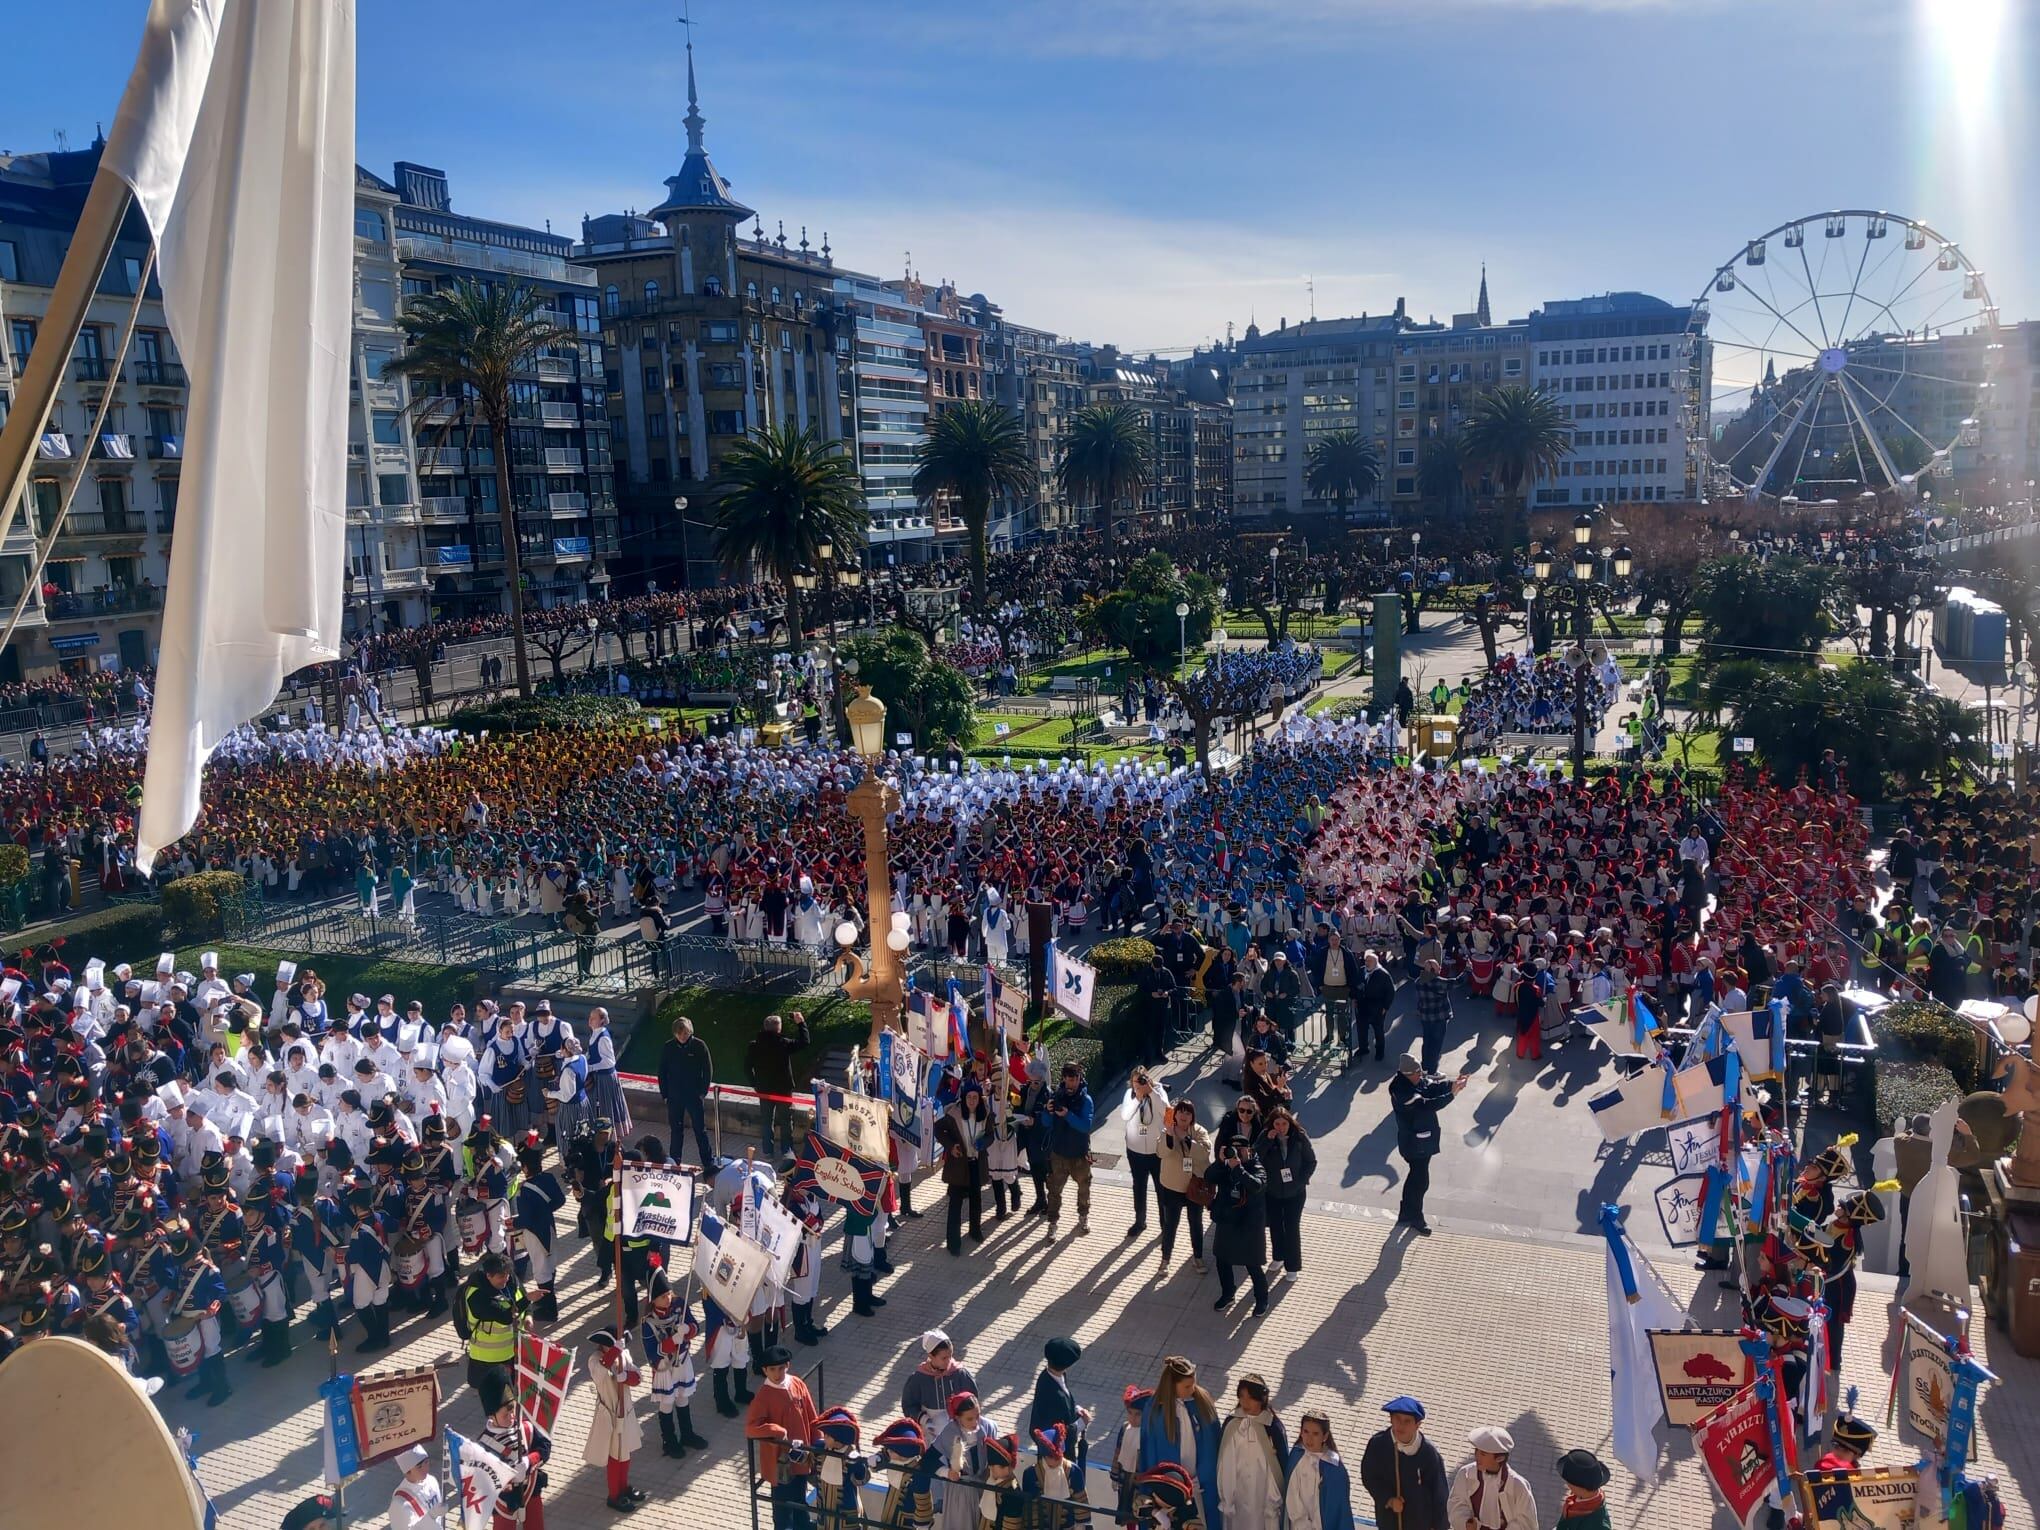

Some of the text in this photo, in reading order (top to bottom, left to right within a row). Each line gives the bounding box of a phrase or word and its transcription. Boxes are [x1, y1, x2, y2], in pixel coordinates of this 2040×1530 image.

[632, 1171, 682, 1191] Donostia
[815, 1164, 865, 1195] English School
[368, 1383, 430, 1402] ANUNCIATA
[1668, 1386, 1732, 1397] ARANTZAZUKO
[1818, 1486, 1837, 1509] 1974
[1854, 1481, 1920, 1498] MENDIOL
